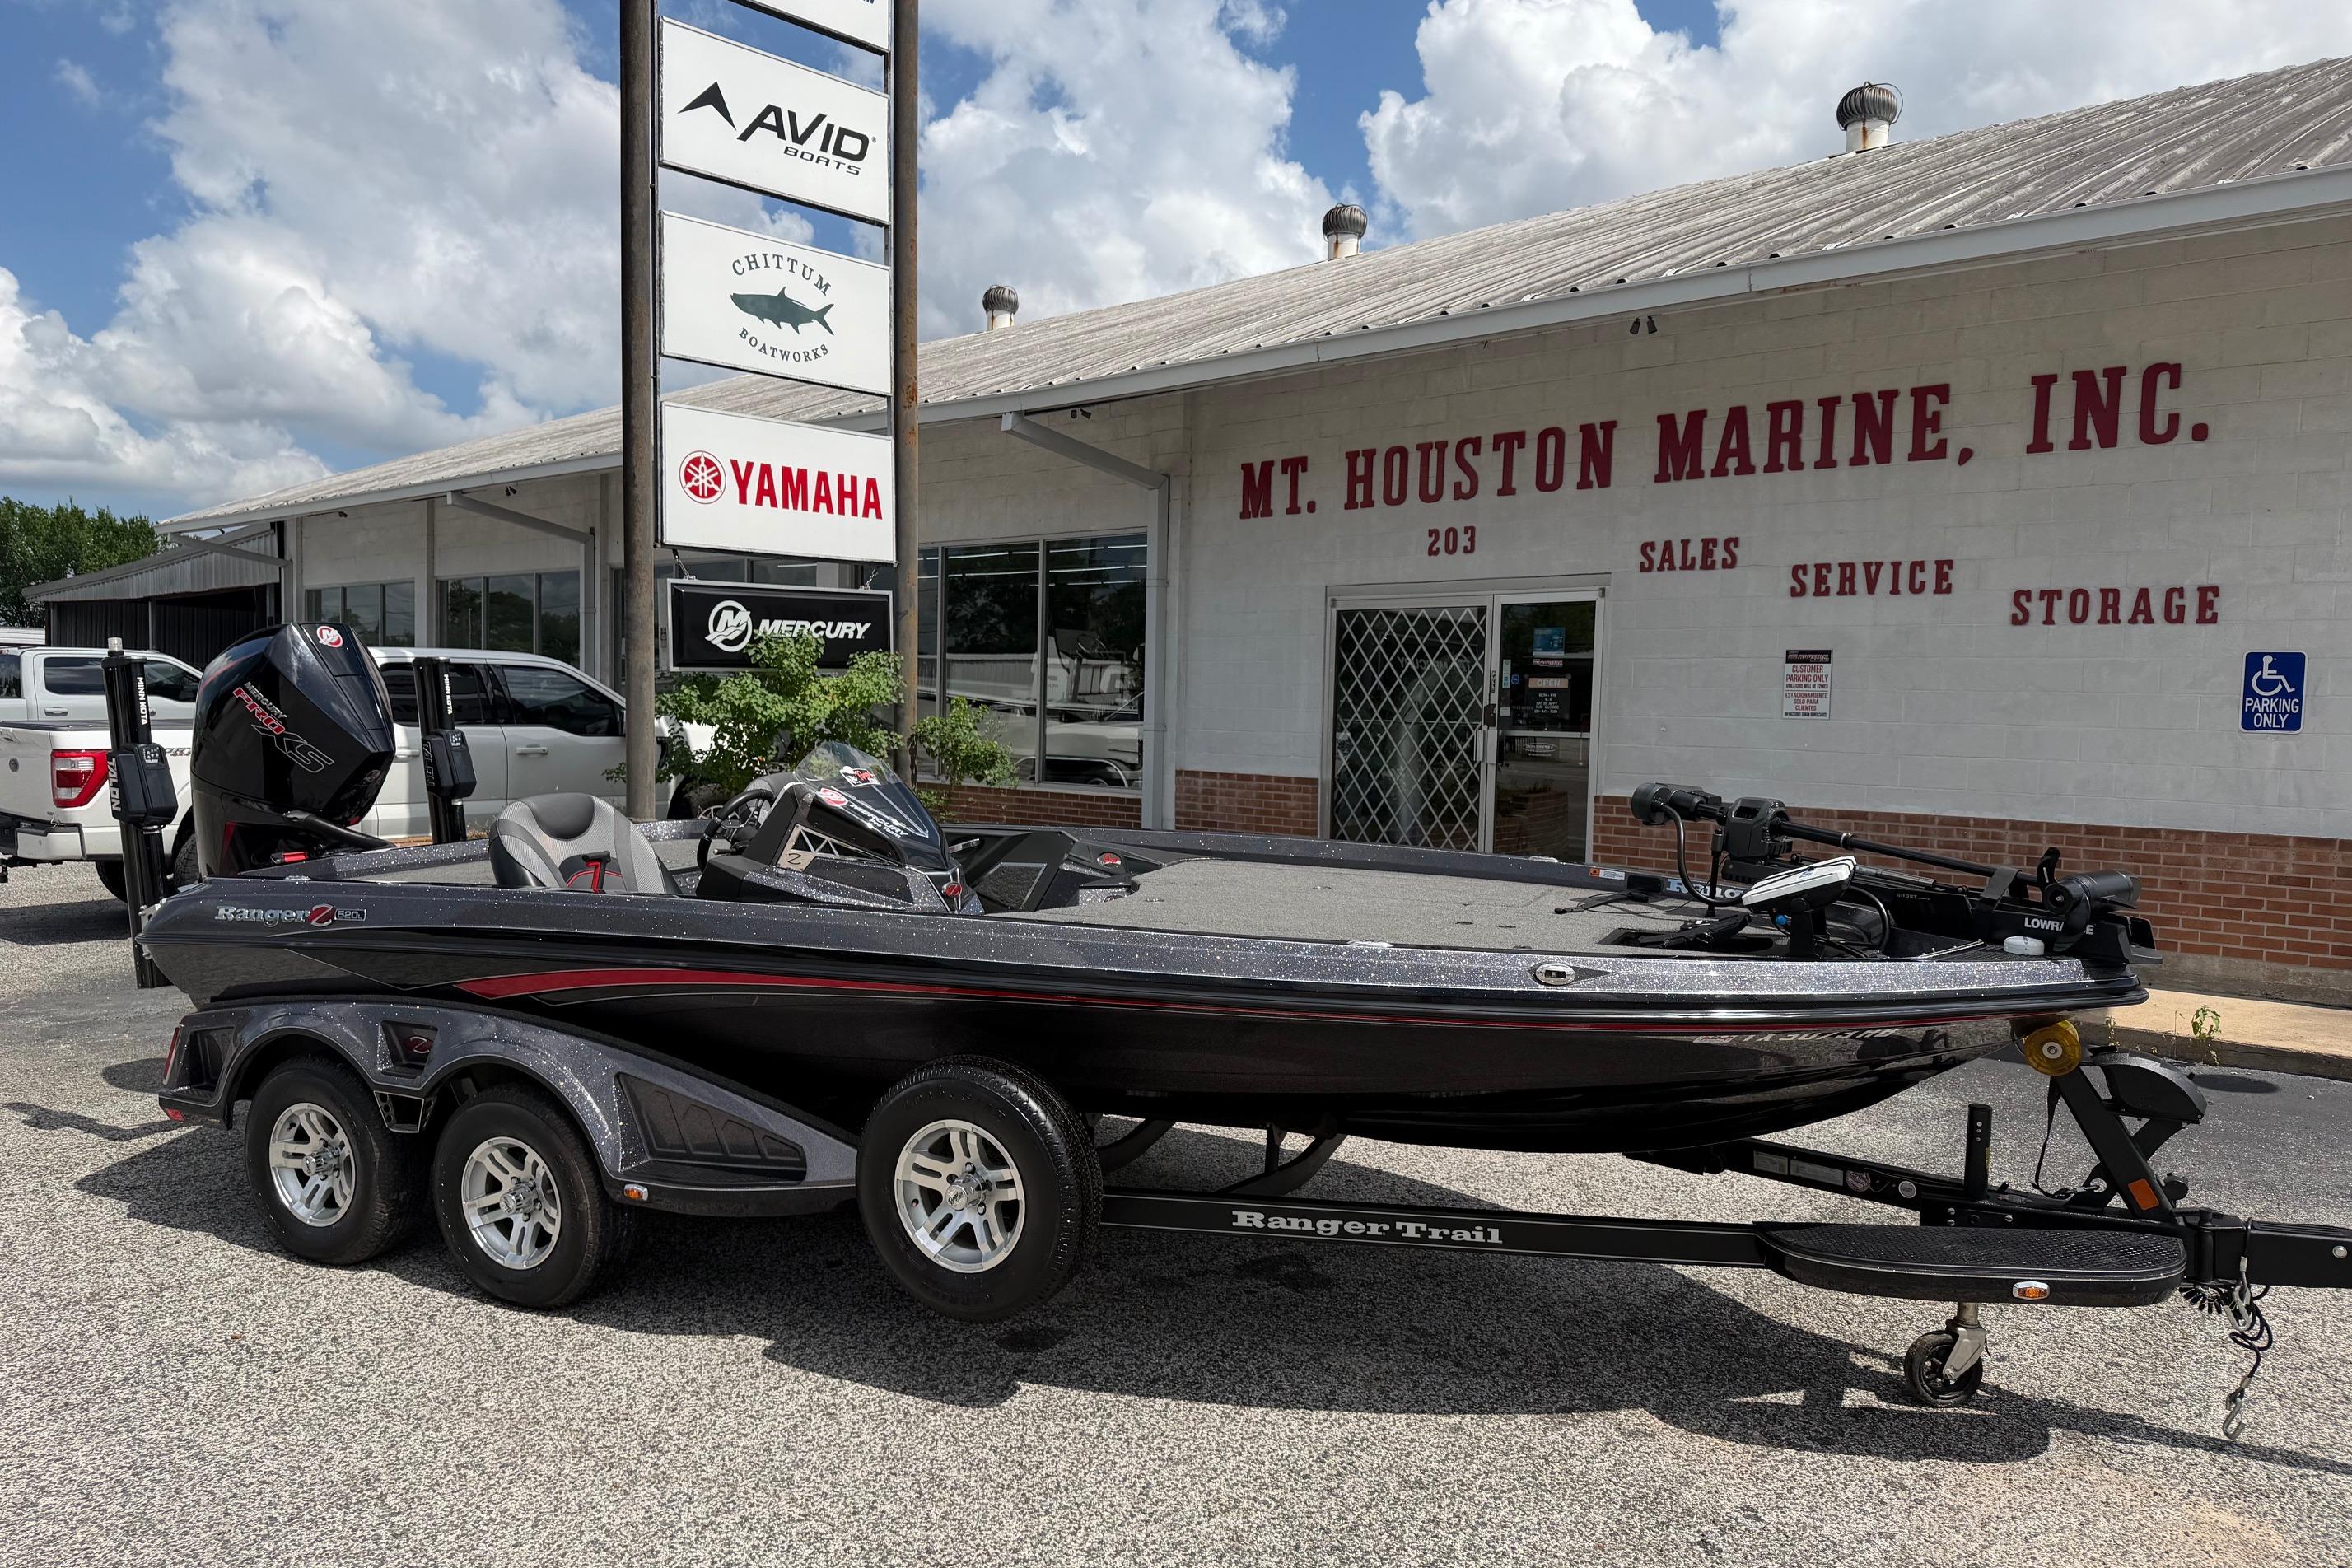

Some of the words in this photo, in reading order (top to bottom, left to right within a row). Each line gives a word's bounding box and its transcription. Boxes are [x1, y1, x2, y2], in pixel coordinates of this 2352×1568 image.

[736, 104, 870, 162] AVID
[783, 146, 861, 175] BOATS
[732, 253, 832, 296] CHITTUM
[739, 328, 828, 362] BOATWORKS
[1239, 456, 1317, 520] MT.
[1344, 420, 1618, 511] HOUSTON
[1654, 383, 1974, 483] MARINE,
[2026, 362, 2209, 454] INC.
[730, 459, 883, 520] YAMAHA
[1427, 525, 1477, 557] 203
[1640, 537, 1740, 572] SALES
[1790, 559, 1953, 597] SERVICE
[2011, 586, 2219, 626] STORAGE
[758, 619, 871, 639] MERCURY
[443, 674, 451, 695] MINN
[1536, 679, 1561, 688] OPEN
[1785, 674, 1812, 683] PARKING
[1813, 674, 1828, 683] ONLY
[1791, 665, 1823, 673] CUSTOMER
[137, 676, 146, 701] MINN
[244, 681, 287, 719] MERCURY
[139, 701, 148, 726] KOTA
[232, 687, 286, 735] PRO
[446, 694, 454, 716] KOTA
[2245, 698, 2300, 713] PARKING
[2253, 713, 2289, 728] ONLY
[250, 724, 335, 773] XS
[107, 758, 121, 811] TALON
[849, 803, 908, 836] MERCURY
[215, 905, 310, 927] Ranger
[2024, 917, 2094, 935] LOWRE
[1232, 1211, 1389, 1236] Ranger
[1395, 1221, 1503, 1244] Trail
